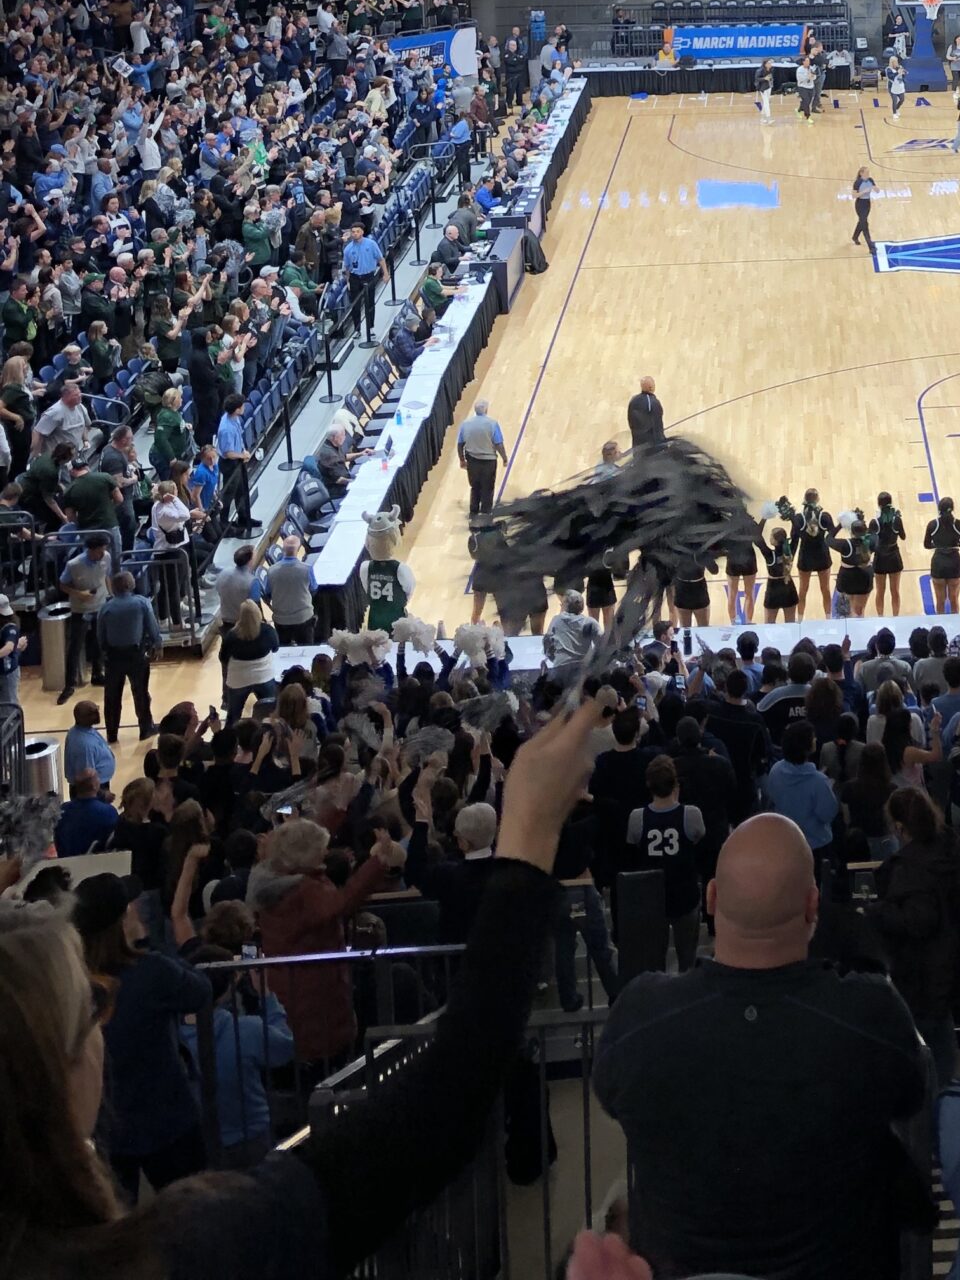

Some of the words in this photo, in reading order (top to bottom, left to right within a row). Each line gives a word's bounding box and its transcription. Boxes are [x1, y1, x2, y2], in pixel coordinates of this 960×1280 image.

[693, 37, 734, 49] MARCH
[737, 35, 799, 48] MADNESS
[370, 581, 393, 602] 64
[648, 828, 679, 856] 23
